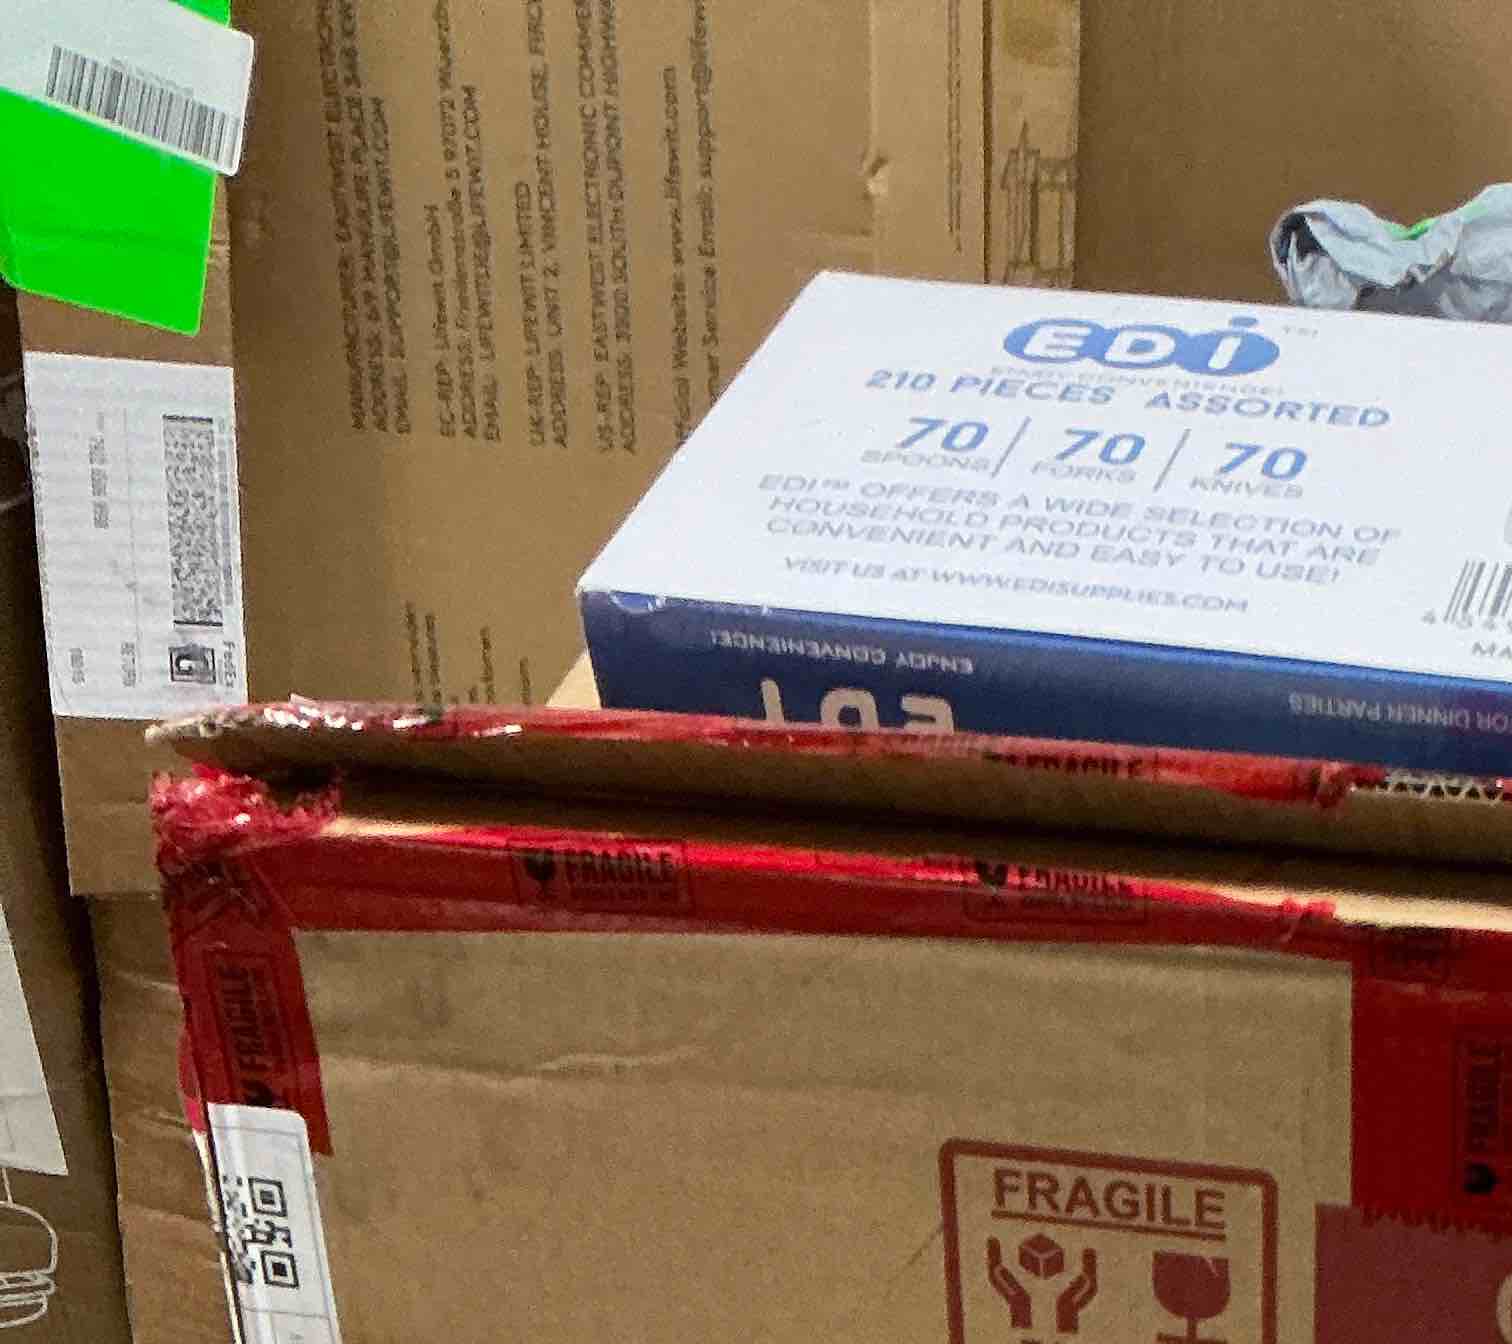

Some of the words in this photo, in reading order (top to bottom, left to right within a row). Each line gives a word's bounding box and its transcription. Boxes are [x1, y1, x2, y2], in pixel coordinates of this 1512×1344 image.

[579, 103, 603, 243] ELECTRONIC
[603, 102, 624, 202] DUPONT
[514, 181, 536, 268] LIMITED
[608, 207, 629, 283] SOUTH
[588, 248, 609, 362] EASTWEST
[865, 368, 937, 391] 210
[949, 375, 1115, 405] PIECES
[1145, 391, 1391, 428] ASSORTED
[860, 449, 992, 472] SPOONS
[1031, 463, 1137, 484] FORKS
[1190, 476, 1304, 498] KNIVES
[898, 416, 990, 452] 70
[1055, 429, 1147, 466] 70
[1219, 443, 1308, 481] 70
[768, 496, 990, 530] HOUSEHOLD
[999, 513, 1197, 549] PRODUCTS
[1210, 532, 1298, 557] THAT
[1304, 545, 1380, 567] ARE
[858, 482, 999, 507] OFFERS
[1008, 493, 1030, 511] A
[1045, 496, 1133, 520] WIDE
[1143, 506, 1343, 540] SELECTION
[1352, 525, 1400, 543] OF
[766, 518, 996, 552] CONVENIENT
[1002, 536, 1080, 561] AND
[1090, 544, 1186, 569] EASY
[1198, 554, 1246, 576] TO
[1255, 561, 1341, 585] USE!
[784, 556, 851, 577] VISIT
[852, 559, 886, 580] US
[889, 566, 926, 584] AT
[930, 569, 1249, 614] WWW.EDISUPPLIES.COM
[895, 648, 973, 675] ENJOY
[1290, 692, 1382, 721] PARTIES
[1386, 703, 1470, 727] DINNER
[993, 1169, 1227, 1230] FRAGILE
